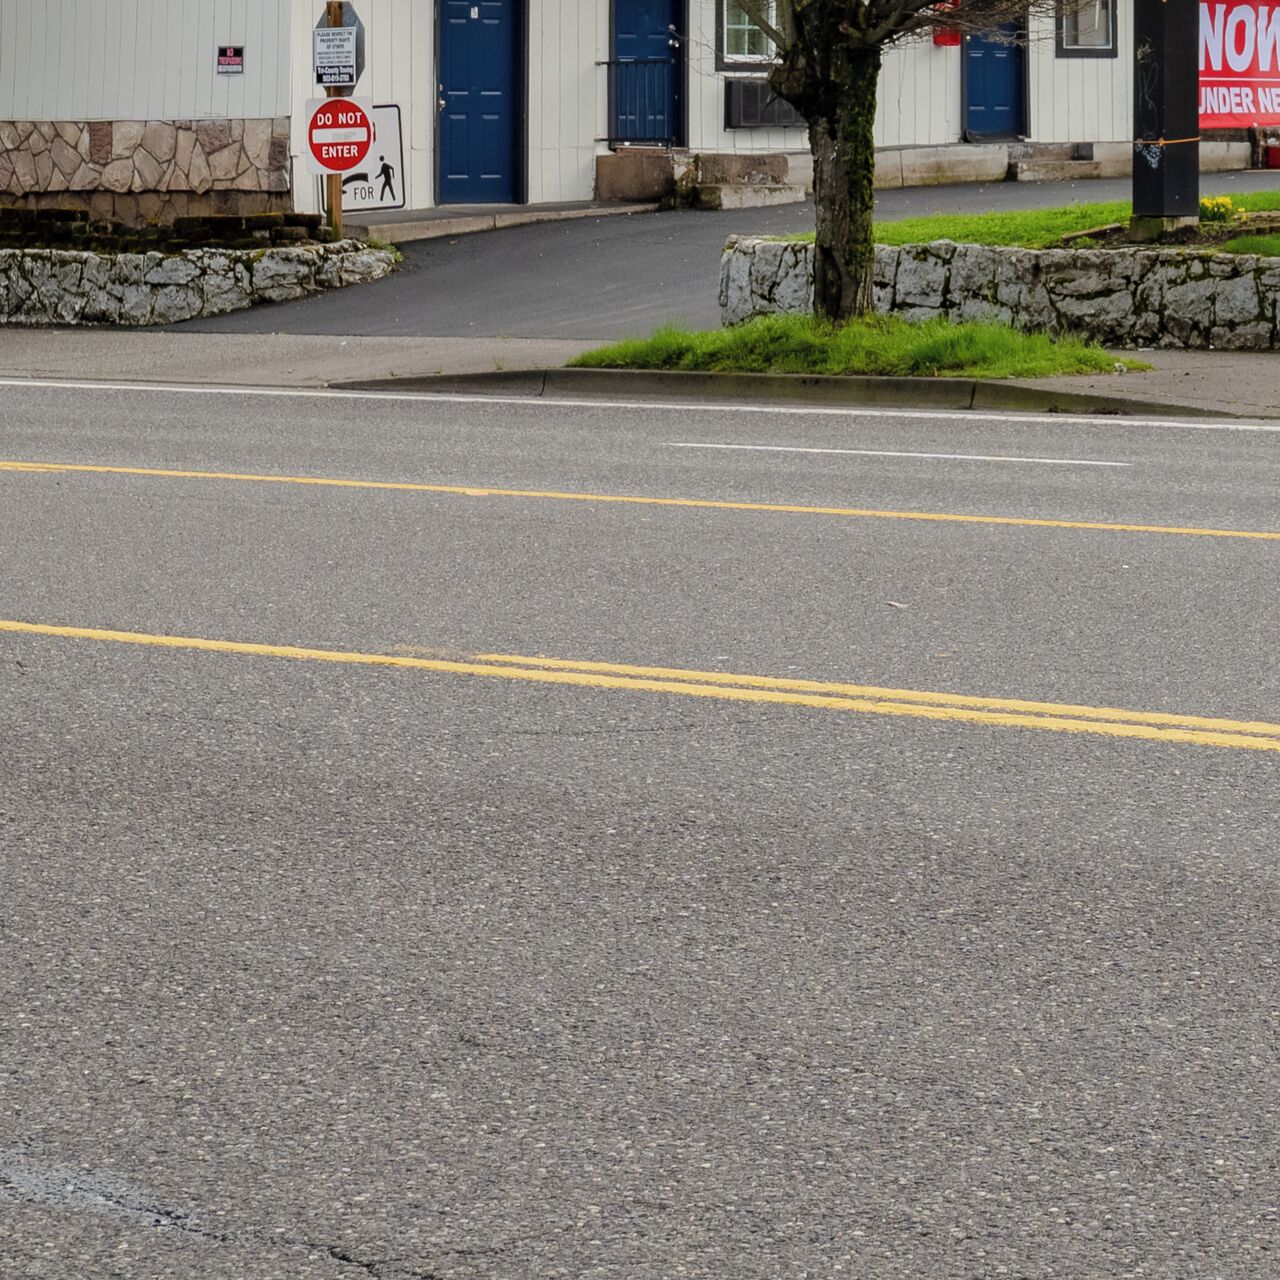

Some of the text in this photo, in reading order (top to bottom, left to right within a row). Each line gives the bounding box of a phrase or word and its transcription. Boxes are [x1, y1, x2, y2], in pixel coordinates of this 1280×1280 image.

[316, 112, 362, 126] DO NOT
[321, 145, 358, 158] ENTER
[353, 186, 374, 200] FOR
